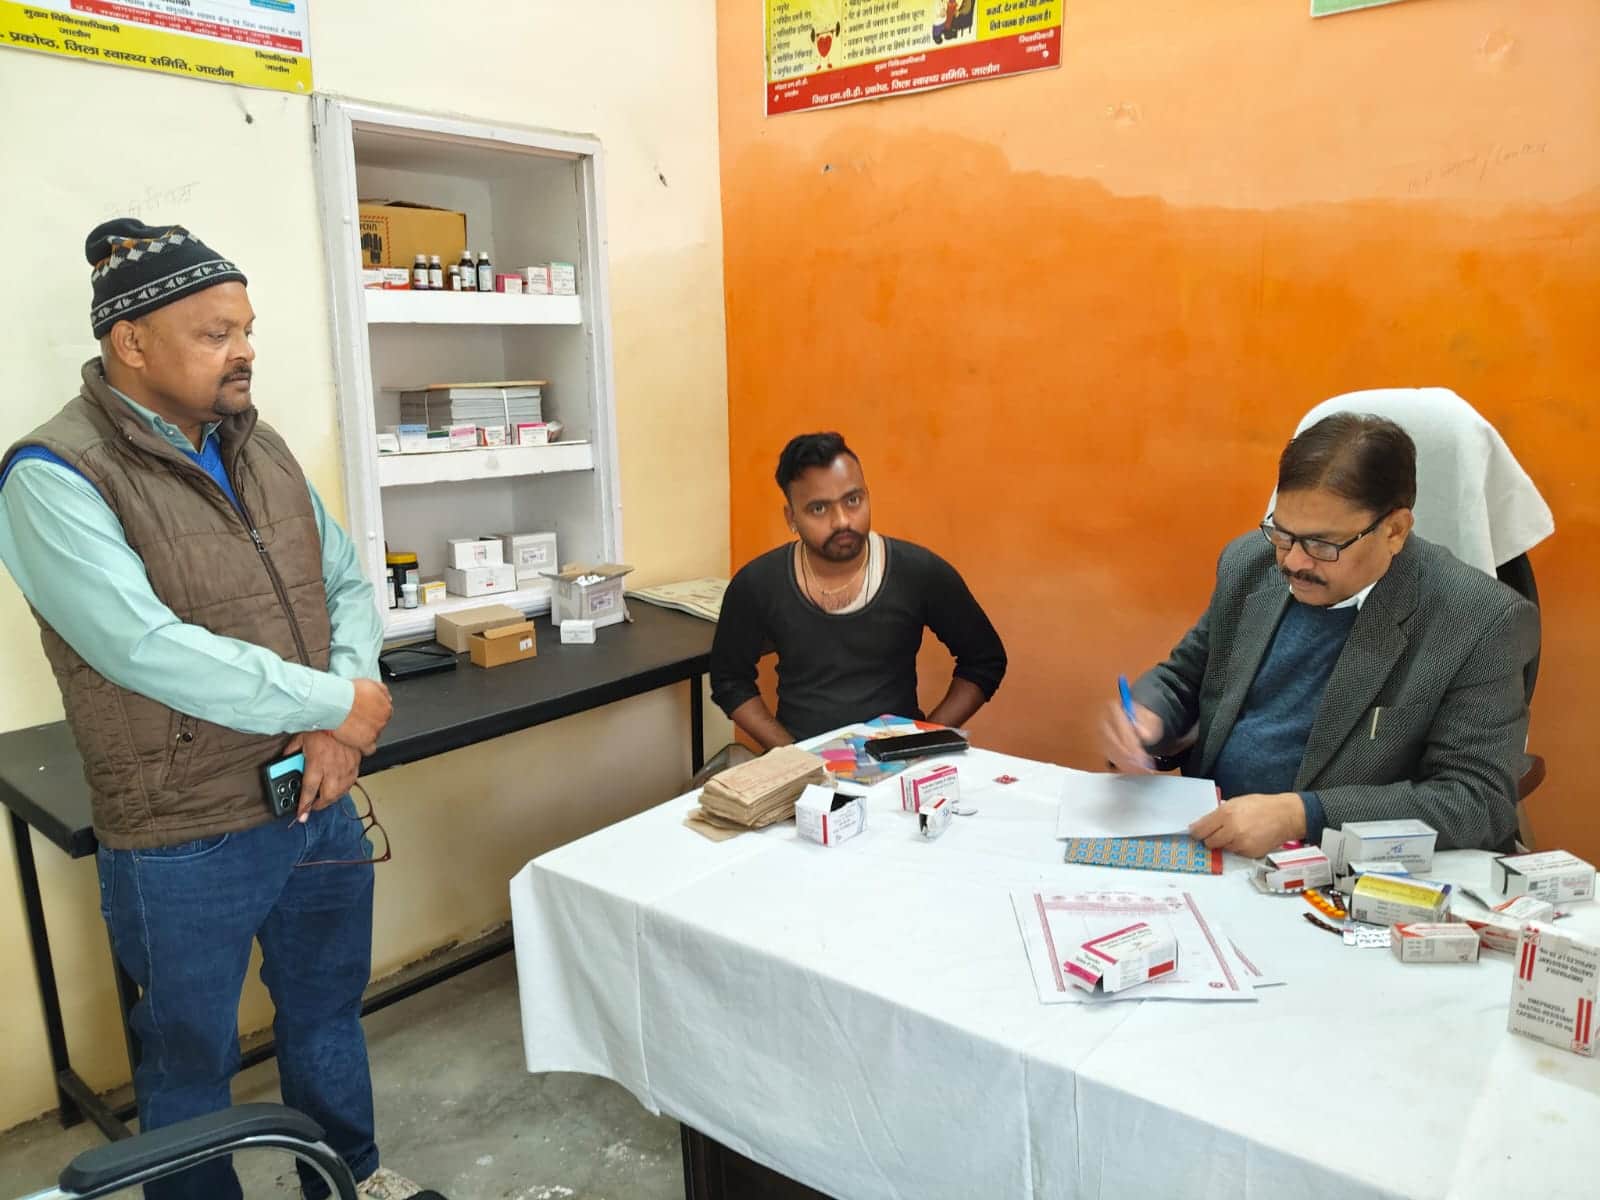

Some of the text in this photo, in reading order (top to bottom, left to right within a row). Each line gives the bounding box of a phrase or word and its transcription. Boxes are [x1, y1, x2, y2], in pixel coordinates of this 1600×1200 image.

[64, 39, 99, 55] जिला
[103, 48, 147, 63] स्वास्थ्य
[195, 64, 234, 78] जालौन
[891, 78, 911, 90] जिला
[912, 74, 939, 86] स्वास्थ्य
[971, 62, 1000, 76] जालौन
